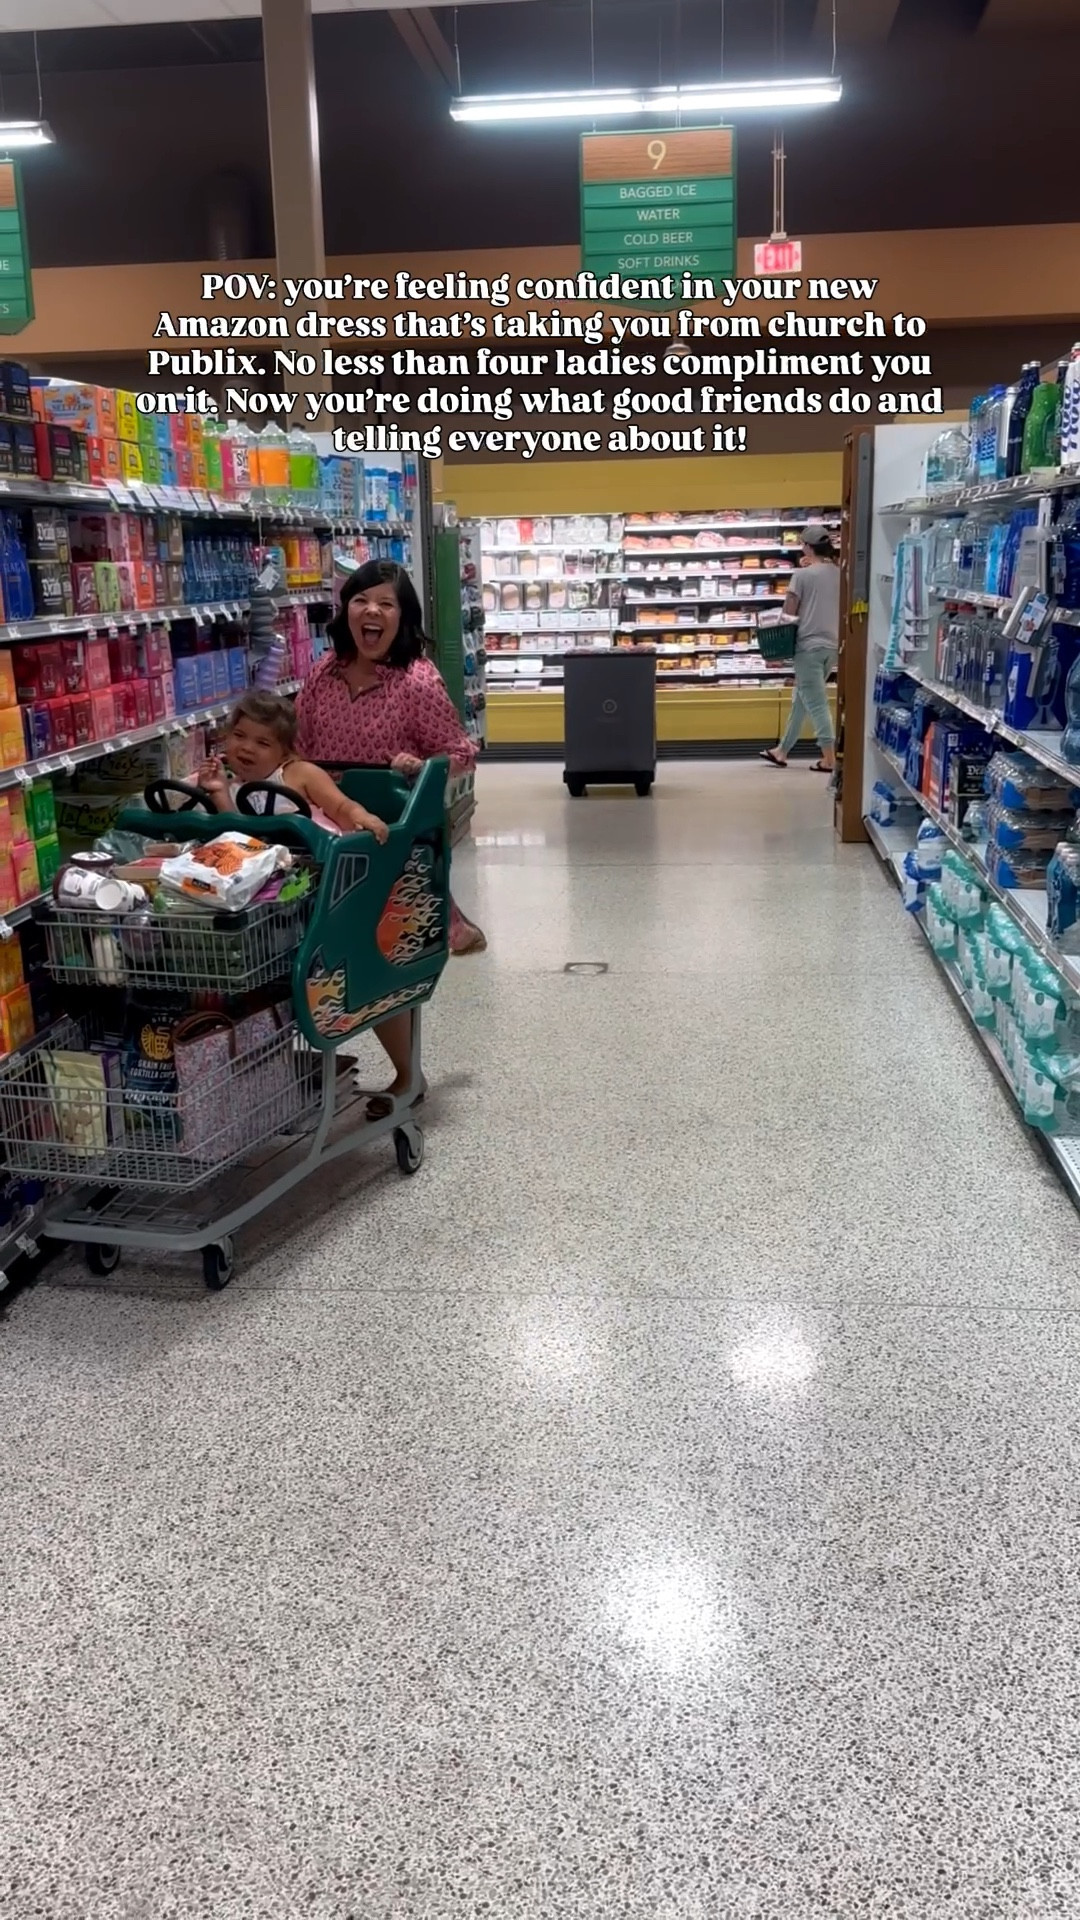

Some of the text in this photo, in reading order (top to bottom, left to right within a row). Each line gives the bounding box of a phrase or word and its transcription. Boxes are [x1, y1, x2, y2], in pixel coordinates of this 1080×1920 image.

[647, 139, 667, 171] 9
[619, 184, 697, 200] BAGGED ICE
[636, 208, 681, 221] WATER
[623, 231, 693, 246] COLD BEER
[617, 254, 700, 270] SOFT DRINKS
[762, 245, 794, 271] EXIT
